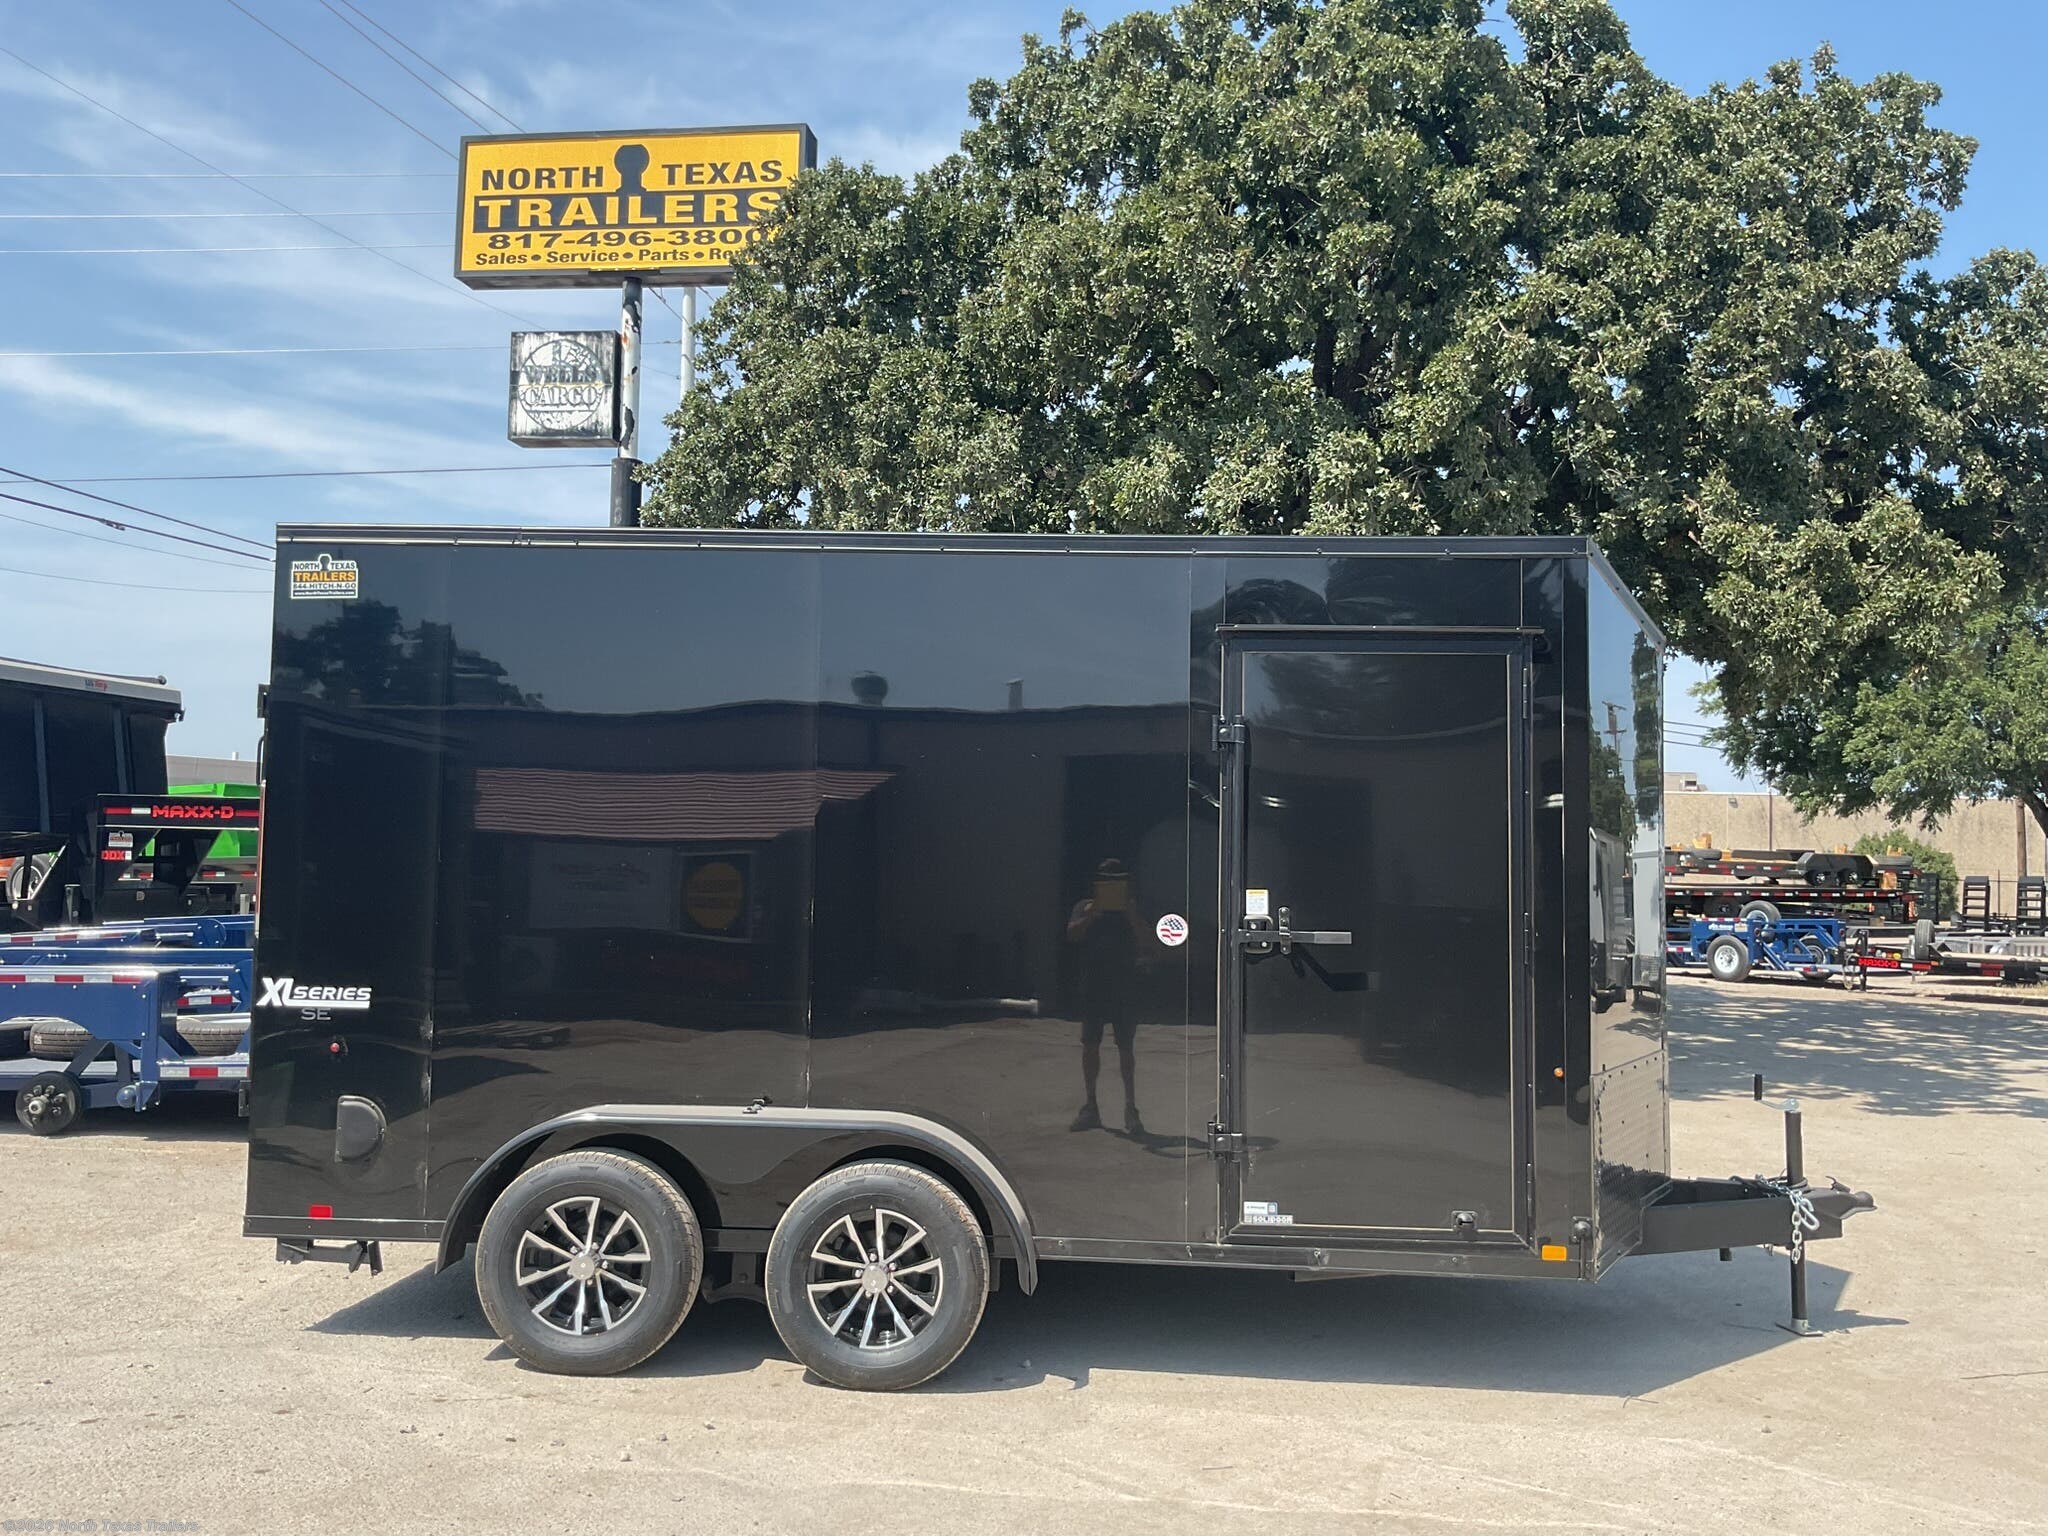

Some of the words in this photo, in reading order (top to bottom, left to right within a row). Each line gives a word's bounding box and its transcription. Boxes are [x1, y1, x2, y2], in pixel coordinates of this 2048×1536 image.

[481, 166, 604, 191] NORTH
[661, 160, 783, 187] TEXAS
[478, 191, 781, 228] TRAILERS
[488, 228, 768, 249] 817-496-3800
[475, 252, 528, 265] Sales
[546, 249, 620, 263] Service
[638, 247, 690, 261] Parts
[523, 385, 598, 404] CARGO
[294, 562, 320, 570] NORTH
[330, 561, 355, 569] TEXAS
[294, 571, 355, 582] TRAILERS
[152, 804, 234, 819] MAXX-D
[1858, 959, 1898, 968] MAXX-D
[293, 986, 372, 1001] SERIES
[301, 1007, 331, 1020] SE
